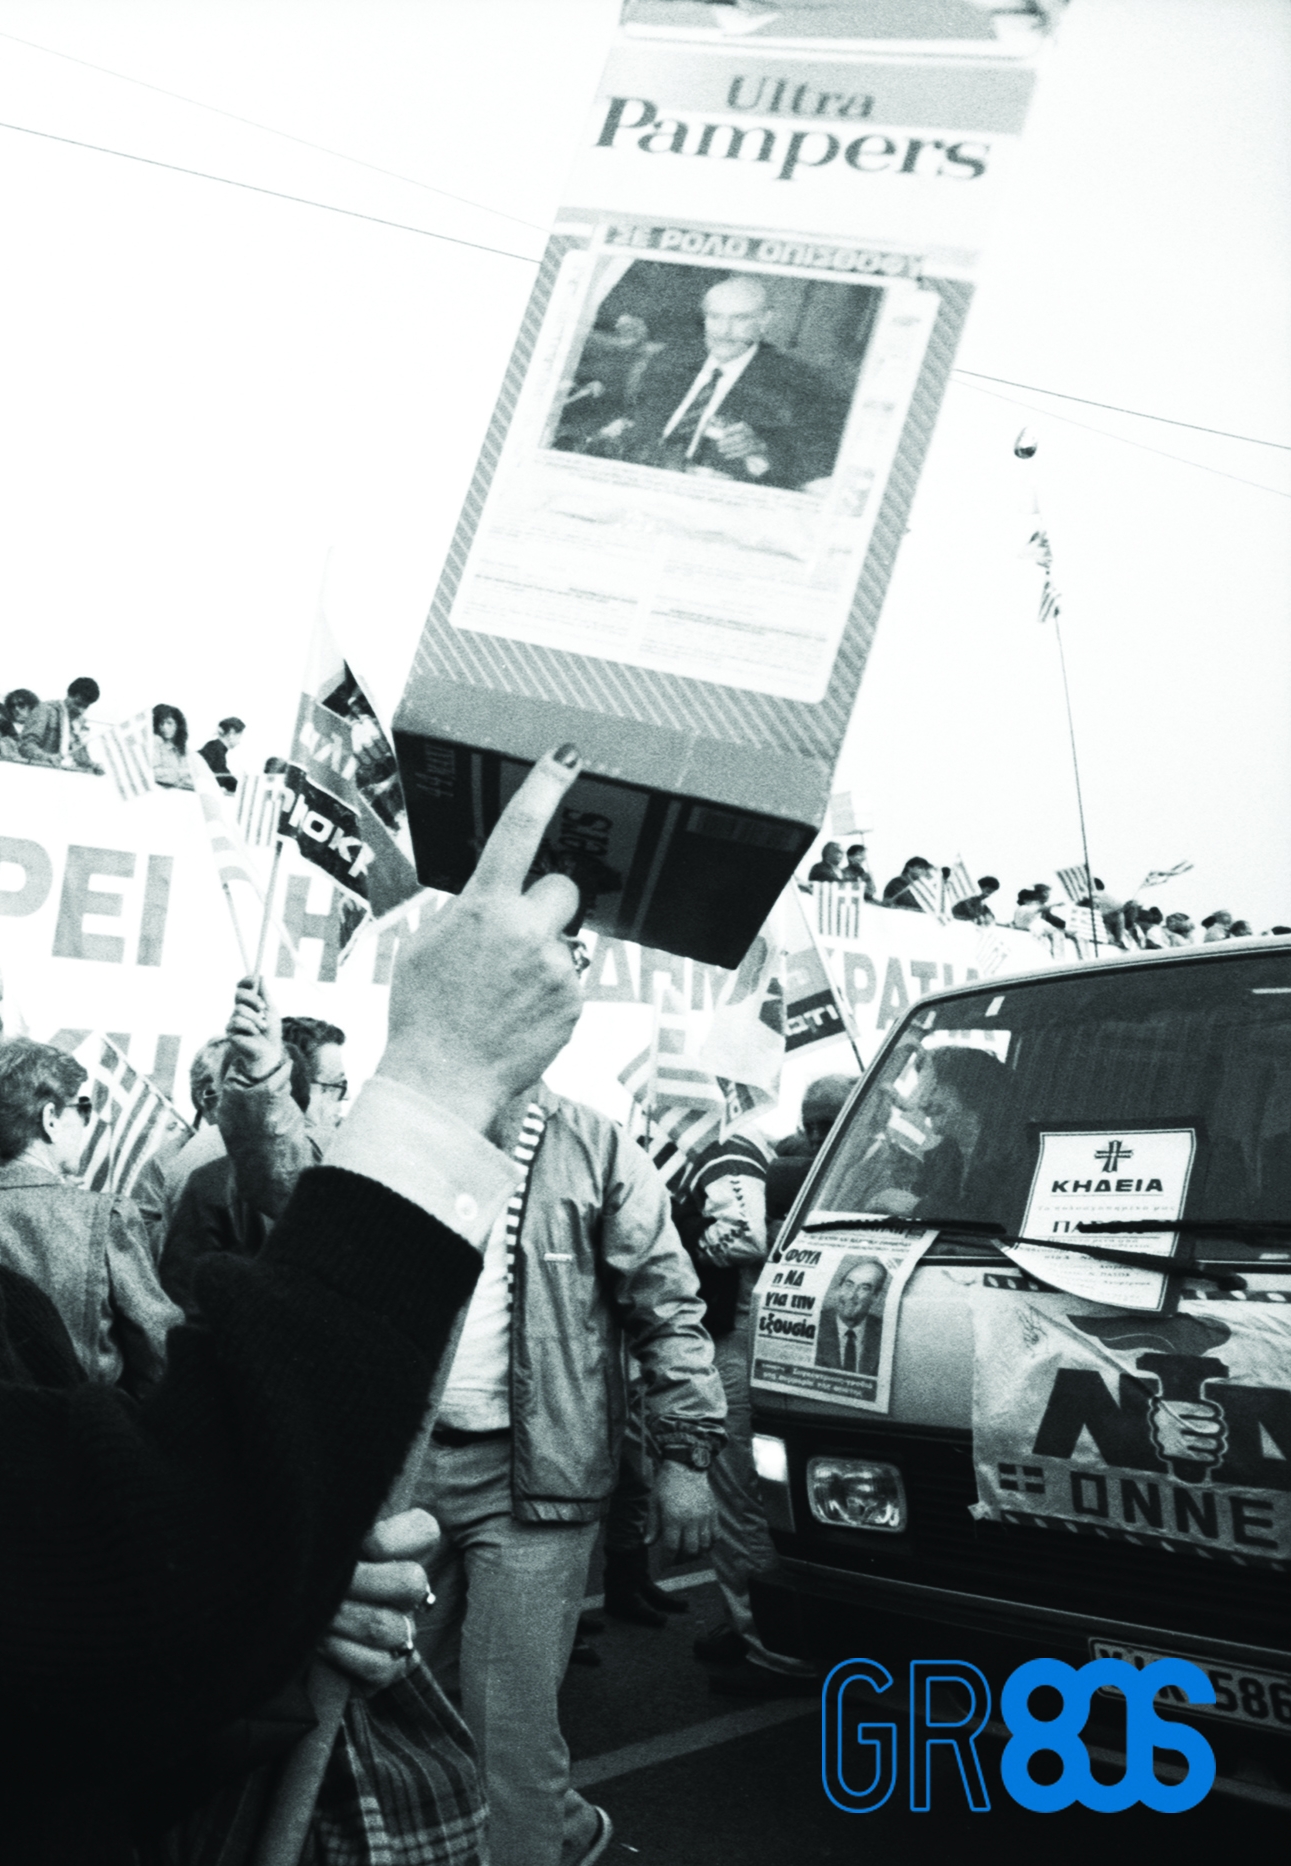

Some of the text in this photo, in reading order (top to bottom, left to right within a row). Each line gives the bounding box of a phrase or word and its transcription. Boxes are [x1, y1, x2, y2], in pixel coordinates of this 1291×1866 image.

[724, 75, 876, 120] Ultra
[591, 95, 992, 182] Pampers
[1051, 1178, 1164, 1193] ΚΗΔΕΙΑ
[785, 1249, 822, 1265] ΦΟΥΛ
[783, 1269, 806, 1287] ΝΔ
[765, 1291, 816, 1310] για την
[759, 1312, 816, 1340] εξουσία
[1070, 1470, 1278, 1549] ΟΝΝΕ
